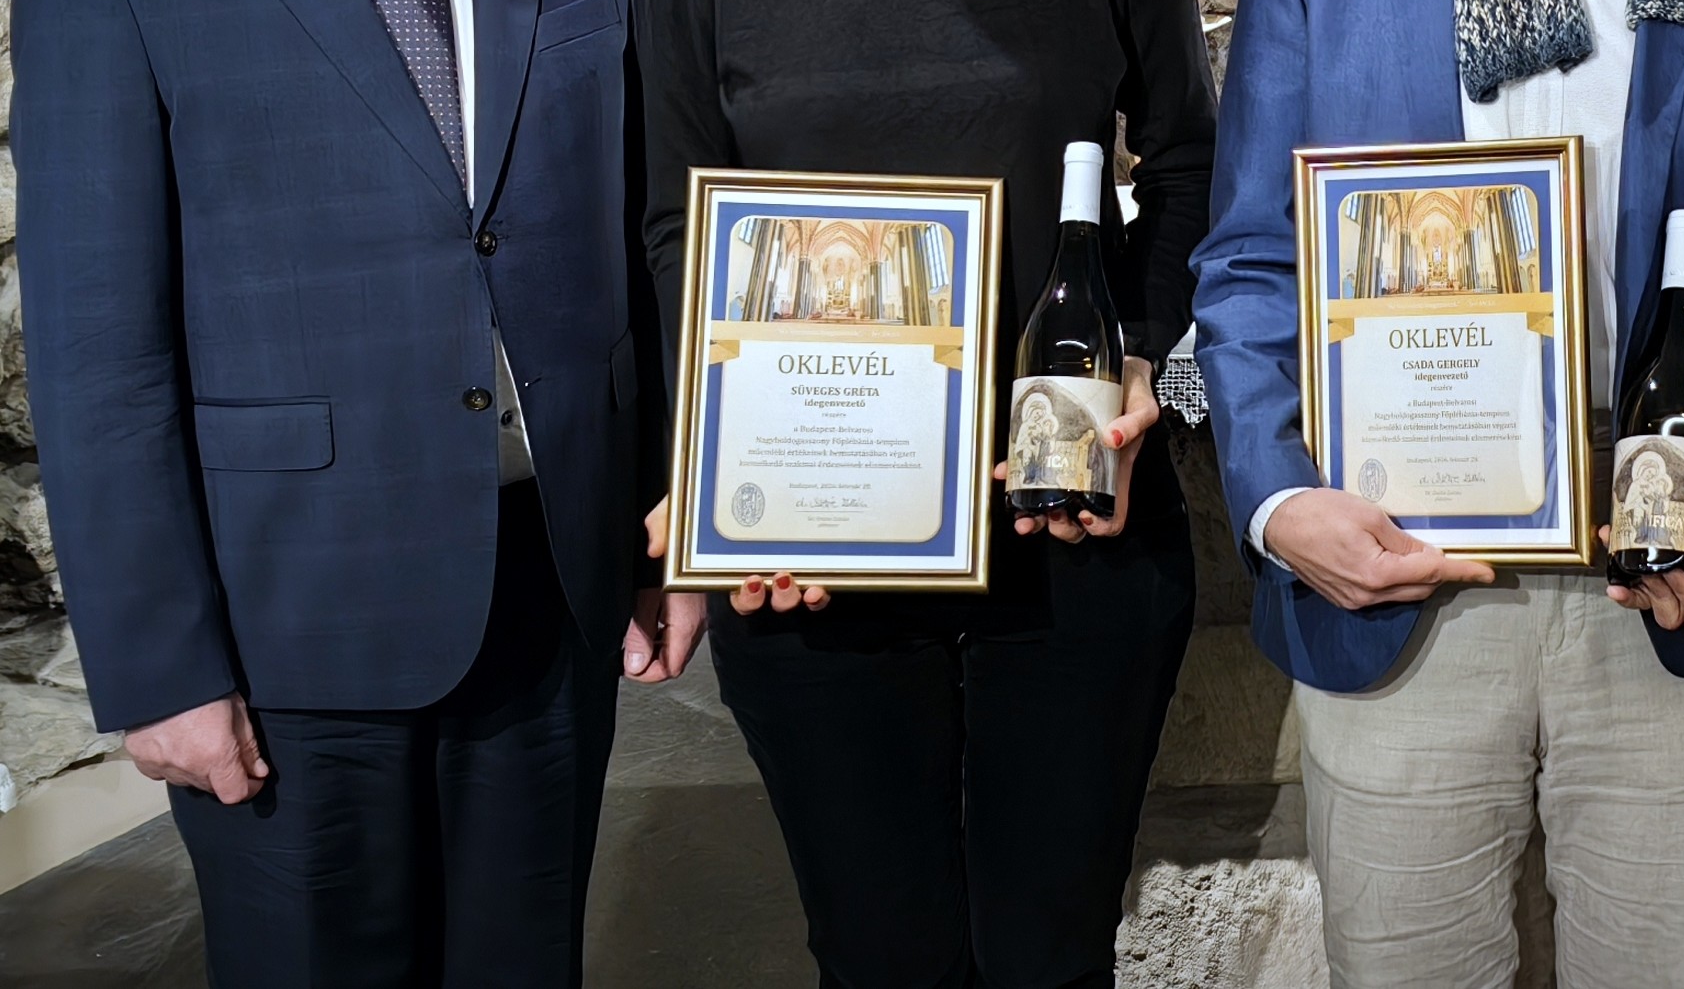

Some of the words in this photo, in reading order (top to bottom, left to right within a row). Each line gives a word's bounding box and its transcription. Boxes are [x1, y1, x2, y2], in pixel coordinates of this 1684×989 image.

[1388, 322, 1493, 349] OKLEVÉL
[778, 351, 895, 376] OKLEVÉL
[1402, 360, 1434, 370] CSADA
[1436, 359, 1480, 369] GERGELY
[1414, 371, 1469, 382] idegenvezető
[790, 384, 841, 397] SÜVEGES
[843, 384, 880, 397] GRÉTA
[804, 398, 866, 409] idegenvezető
